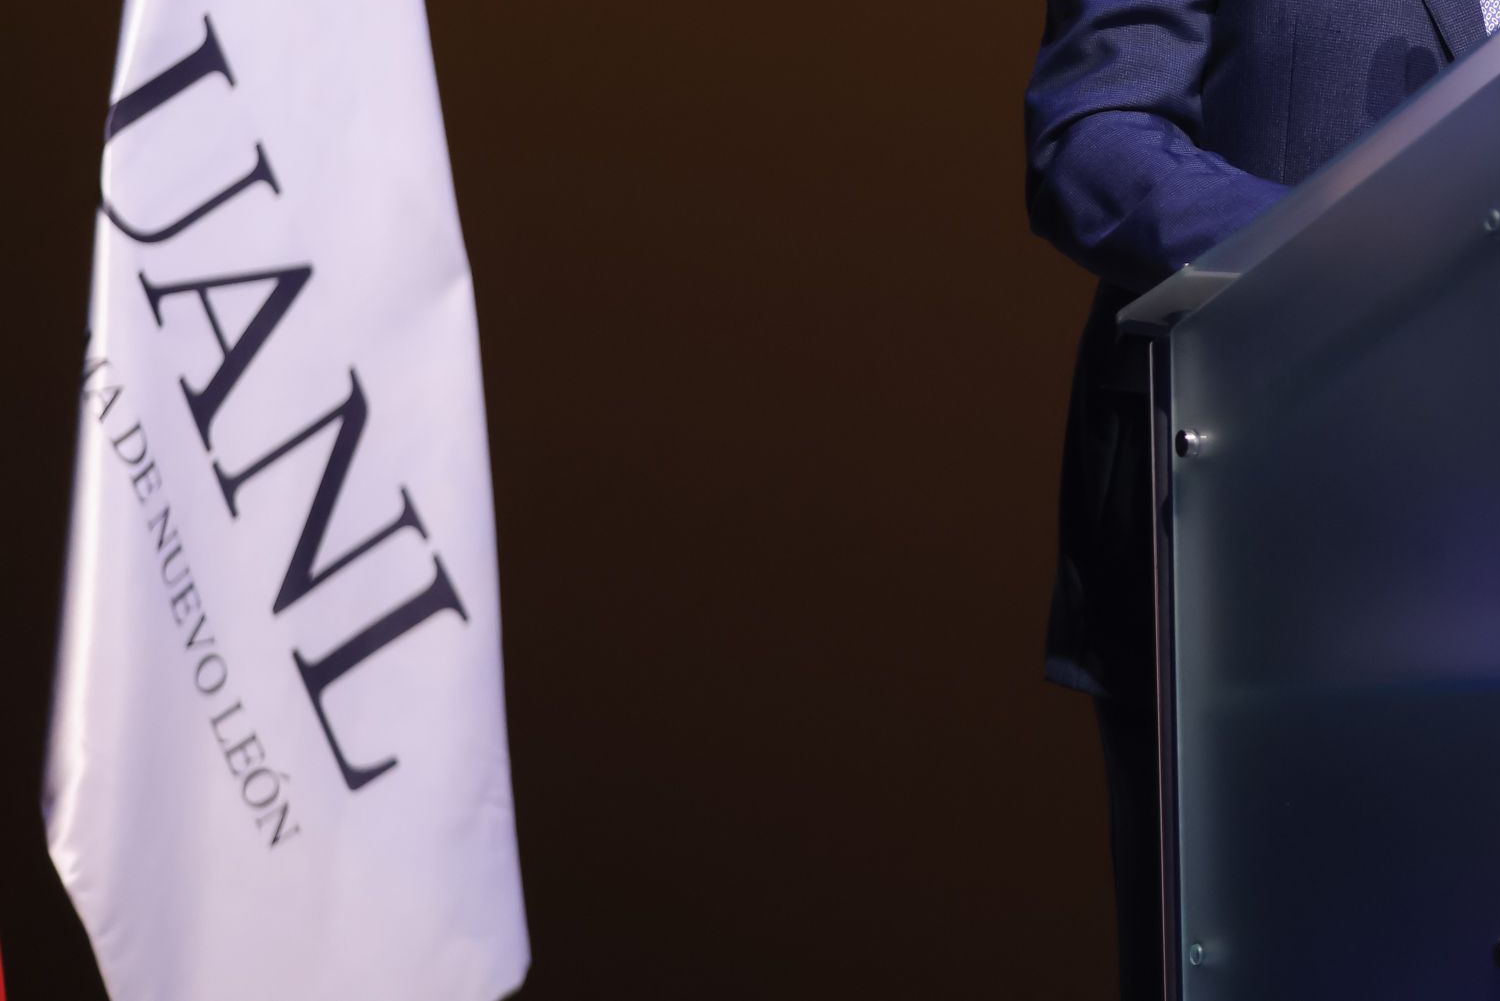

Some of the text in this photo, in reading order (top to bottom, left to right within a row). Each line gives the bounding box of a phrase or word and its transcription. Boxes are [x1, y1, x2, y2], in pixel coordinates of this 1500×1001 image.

[100, 14, 470, 792] UANL
[111, 422, 301, 849] DE NUEVO LEÓN
